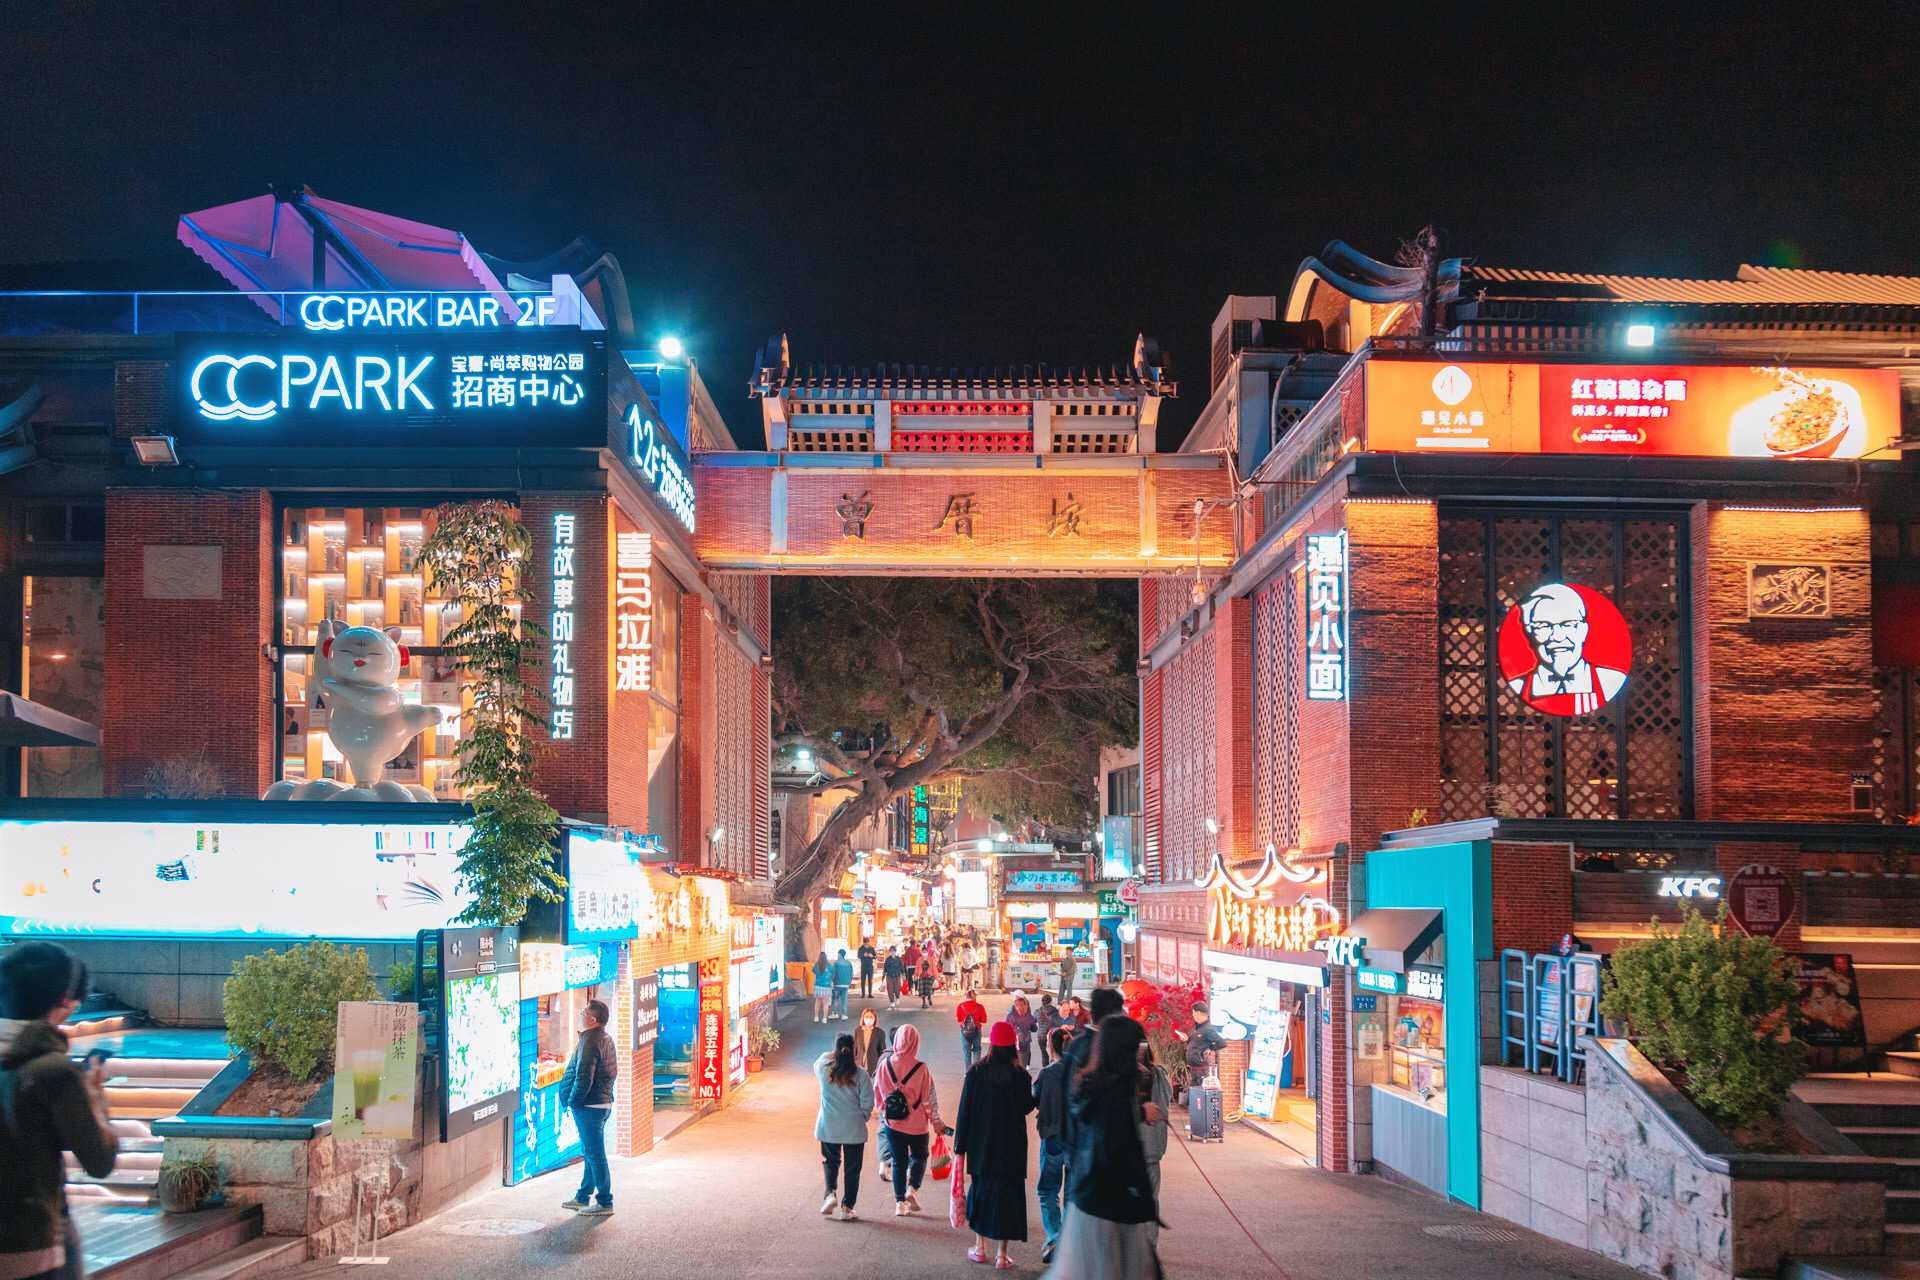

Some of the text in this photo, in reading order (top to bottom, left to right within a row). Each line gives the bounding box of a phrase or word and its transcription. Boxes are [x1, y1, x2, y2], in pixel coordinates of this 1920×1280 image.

[301, 295, 556, 330] CCPARK BAR 2F
[192, 354, 434, 420] CCPARK
[452, 374, 584, 408] 招商中心
[835, 489, 1086, 540] 曾厝垵
[553, 514, 574, 739] 有故事的礼物店
[616, 532, 651, 691] 喜马拉雅
[1307, 532, 1343, 690] 遇见小面
[1658, 877, 1721, 897] KFC
[1327, 935, 1361, 967] KFC
[704, 1014, 718, 1083] 连续五年人气
[700, 1086, 720, 1098] NO.1
